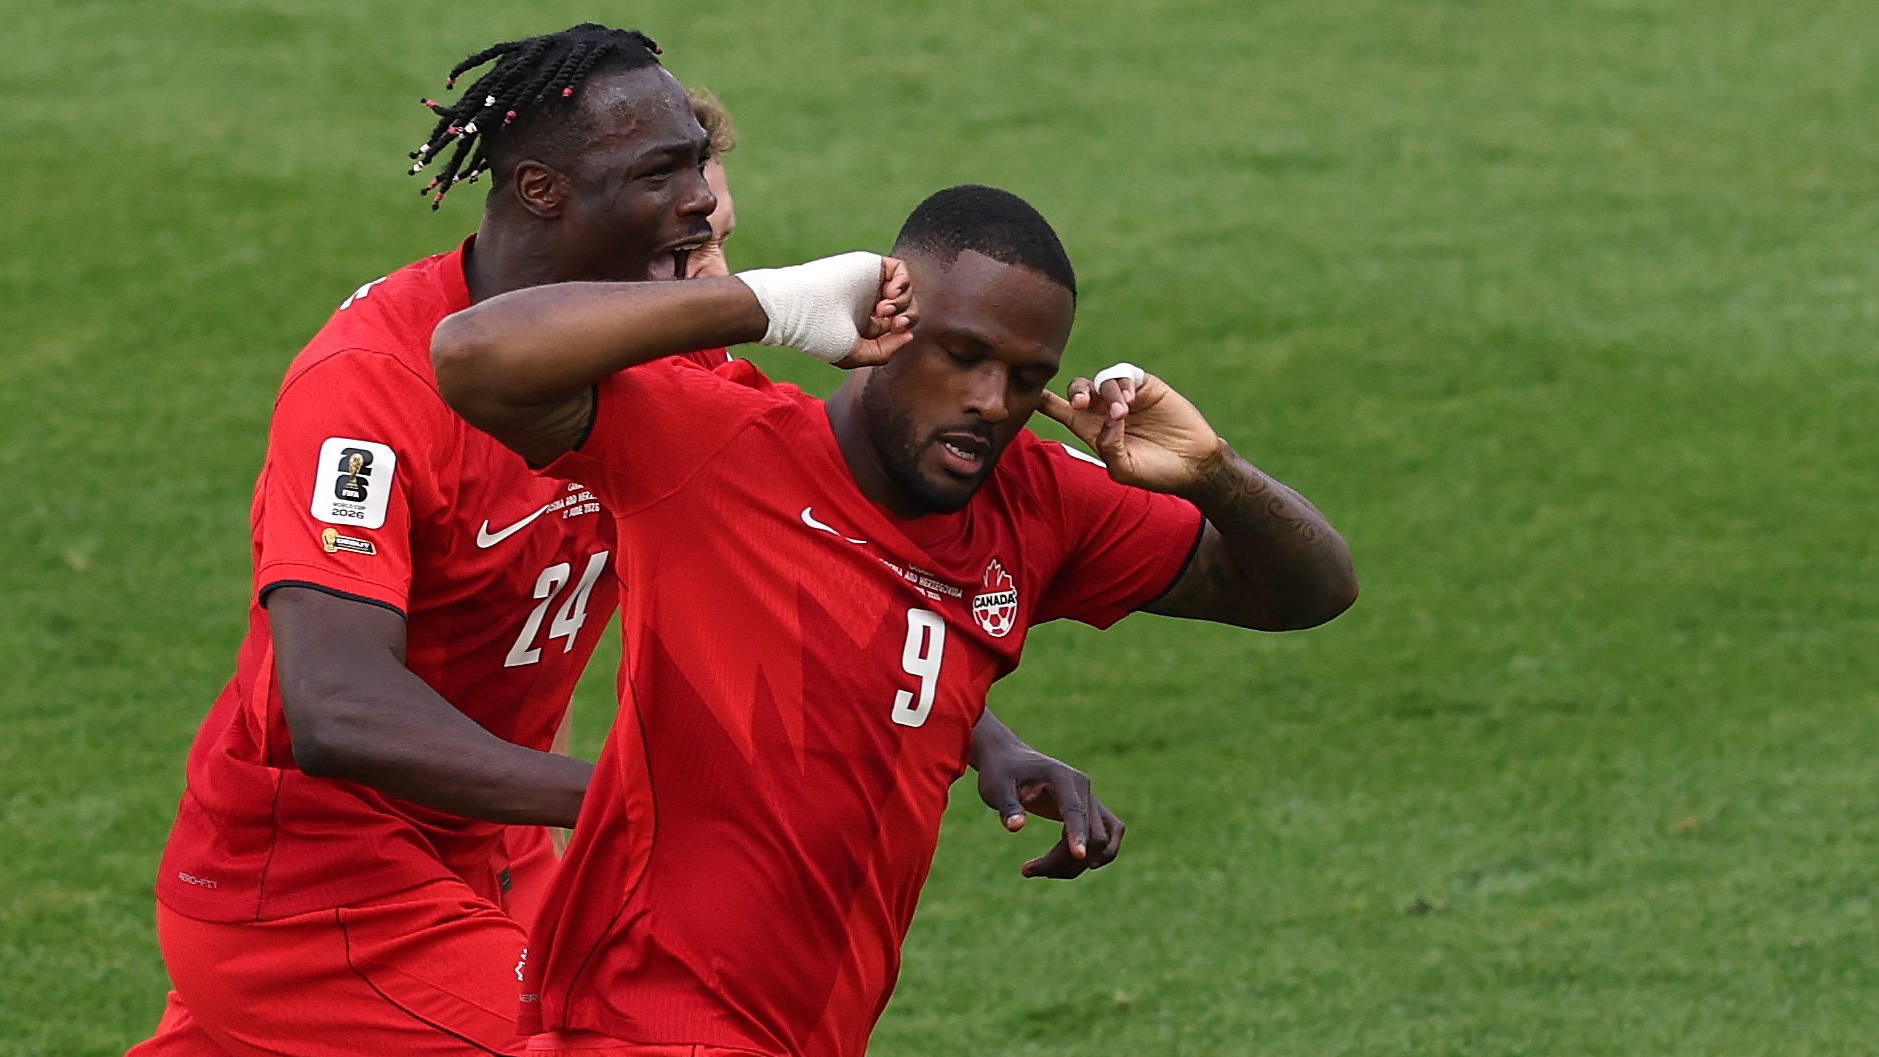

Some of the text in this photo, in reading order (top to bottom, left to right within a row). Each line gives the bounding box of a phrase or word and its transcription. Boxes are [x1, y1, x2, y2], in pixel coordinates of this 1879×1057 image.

[331, 508, 365, 520] 2026
[504, 550, 609, 667] 24
[974, 594, 1016, 609] CANADA
[891, 607, 946, 728] 9
